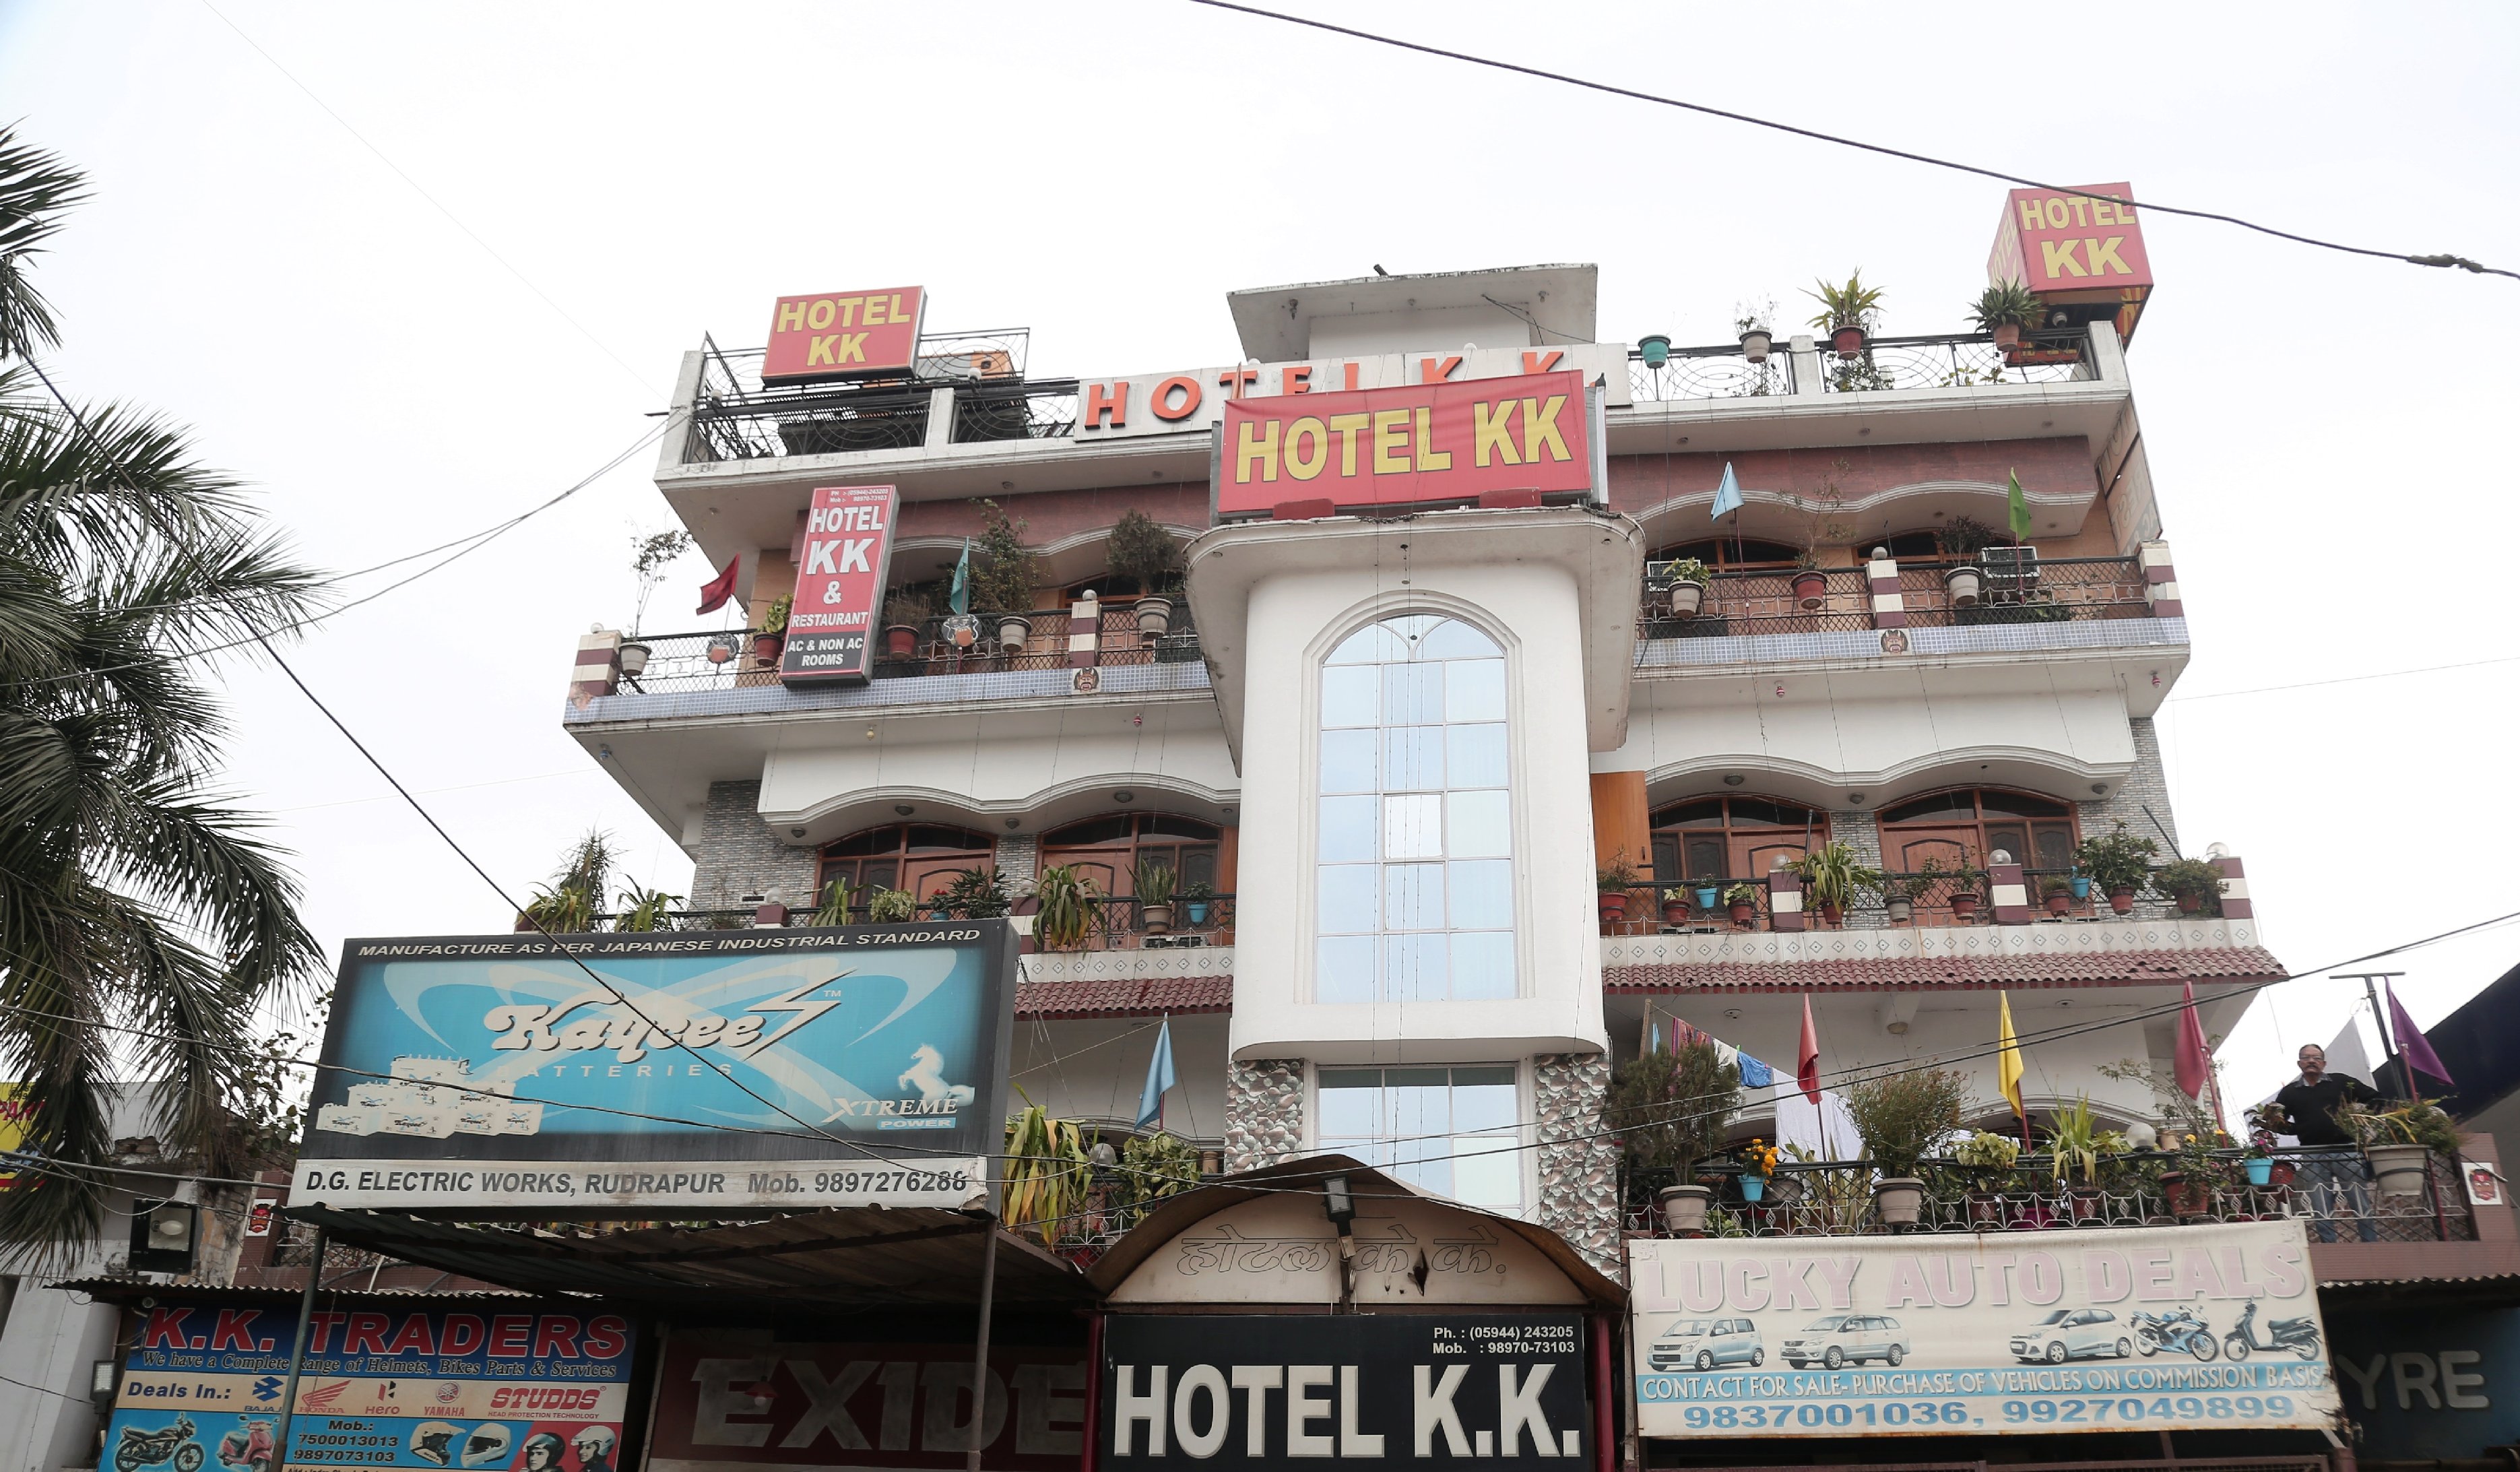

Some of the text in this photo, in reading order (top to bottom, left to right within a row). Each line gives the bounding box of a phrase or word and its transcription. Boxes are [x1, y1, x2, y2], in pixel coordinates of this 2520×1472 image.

[2018, 193, 2137, 231] HOTEL
[2040, 236, 2135, 280] KK
[776, 294, 911, 333] HOTEL
[806, 331, 870, 366] KK
[1234, 394, 1574, 485] HOTEL KK
[809, 505, 884, 534] HOTEL
[806, 538, 876, 575] KK
[823, 580, 842, 604] &
[791, 611, 869, 628] RESTAURANT
[787, 637, 864, 653] AC & NON AC
[801, 653, 845, 667] ROOMS
[358, 929, 981, 957] MANUFACTURE AS PER JAPANESE INDUSTRIAL STANDARD
[820, 1097, 959, 1123] XTREME
[880, 1119, 952, 1128] POWER
[306, 1171, 967, 1197] D.G. ELECTRIC WORKS, RUDRAPUR Mob. 9897276288
[1177, 1224, 1337, 1275] होटल
[1643, 1243, 2306, 1313] LUCKY AUTO DEALS
[143, 1307, 628, 1359] K.K. TRADERS
[1433, 1327, 1456, 1339] Ph.
[1469, 1326, 1520, 1341] (05944)
[1524, 1326, 1574, 1338] 243205
[1433, 1342, 1467, 1354] Mob.
[1487, 1341, 1575, 1353] 98970-73103
[142, 1351, 617, 1378] We have a Complete Range of Helmets, Bikes Parts & Services
[127, 1381, 187, 1398] Deals
[1642, 1376, 1745, 1400] CONTACT
[1749, 1376, 1790, 1399] FOR
[1852, 1372, 1957, 1397] PURCHASE
[1958, 1372, 1986, 1393] OF
[1991, 1370, 2083, 1393] VEHICLES
[2088, 1369, 2122, 1391] ON
[2124, 1366, 2258, 1390] COMMISSION
[298, 1405, 345, 1414] HONDA
[424, 1406, 465, 1417] YAMAHA
[490, 1387, 602, 1411] STUDDS
[690, 1358, 1087, 1455] EXIDE
[1113, 1364, 1581, 1459] HOTEL K.K.
[328, 1419, 374, 1432] Mob.:
[1683, 1395, 2294, 1430] 9837001036, 9927049899
[298, 1433, 399, 1447] 7500013013
[294, 1448, 395, 1463] 9897073103
